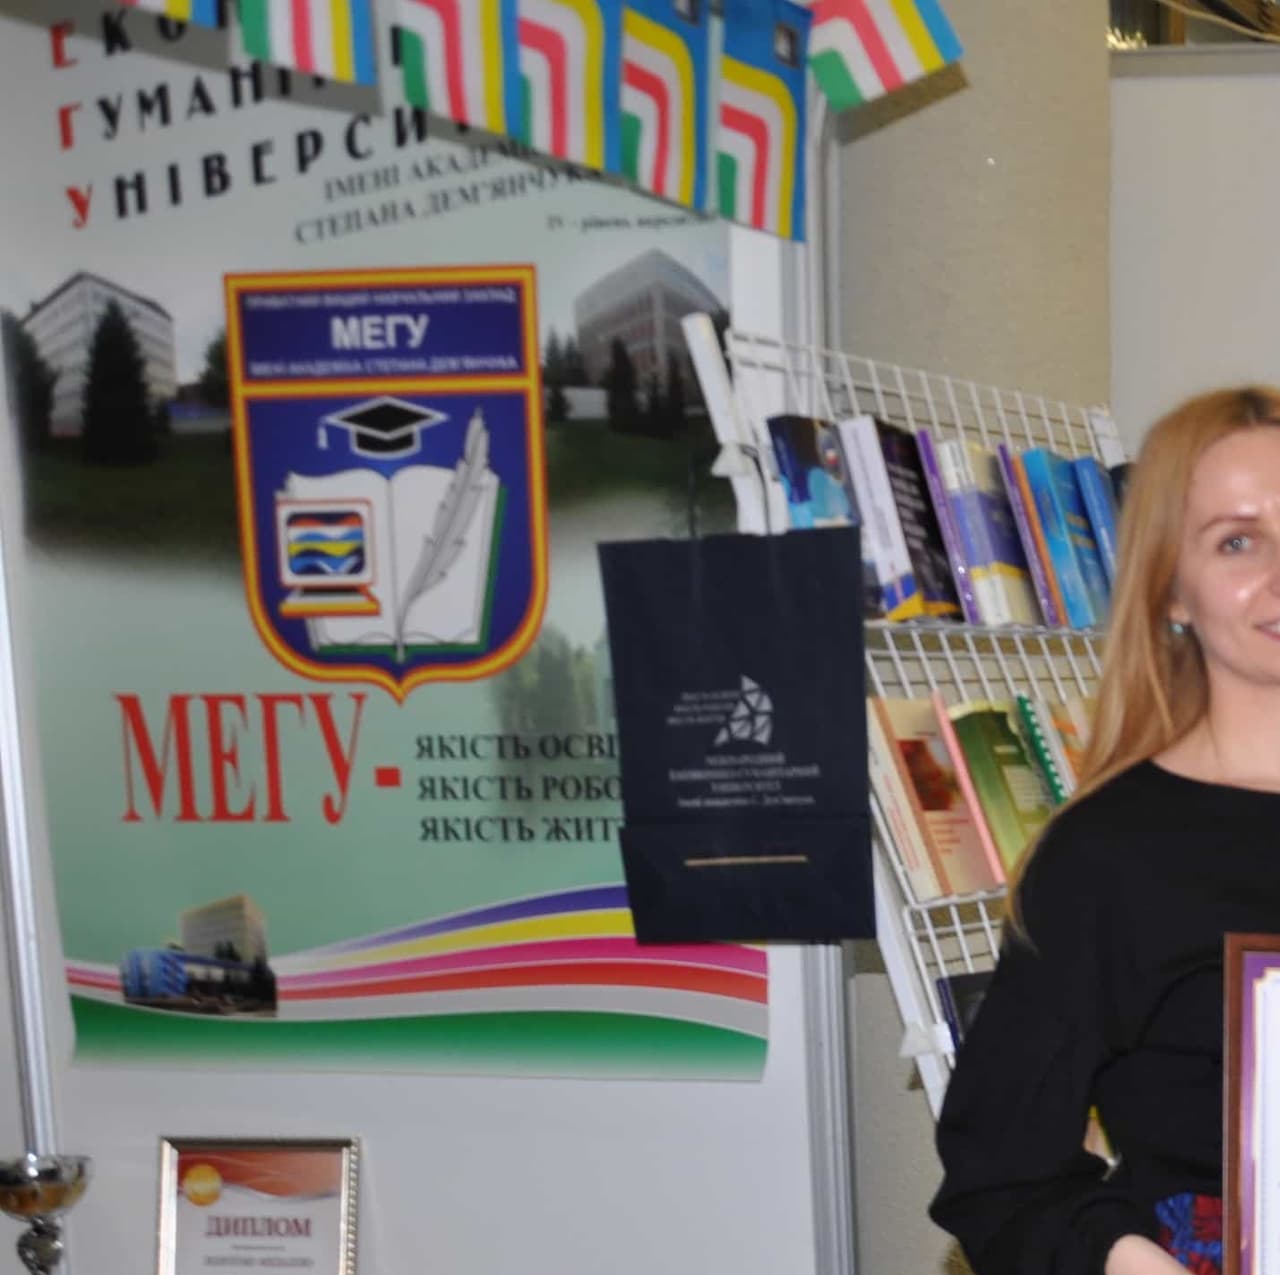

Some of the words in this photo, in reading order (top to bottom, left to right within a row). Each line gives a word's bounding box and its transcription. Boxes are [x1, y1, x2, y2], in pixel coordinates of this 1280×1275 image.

[67, 107, 468, 229] УНІВЕРСИ
[294, 203, 416, 244] СТЕПАНА
[330, 313, 429, 350] МЕГУ
[416, 735, 531, 760] ЯКІСТЬ
[538, 732, 618, 761] ОСВІ
[417, 775, 533, 802] ЯКІСТЬ
[541, 774, 623, 802] РОБО
[420, 817, 535, 843] ЯКІСТЬ
[205, 1215, 312, 1238] ДИПЛОМ
